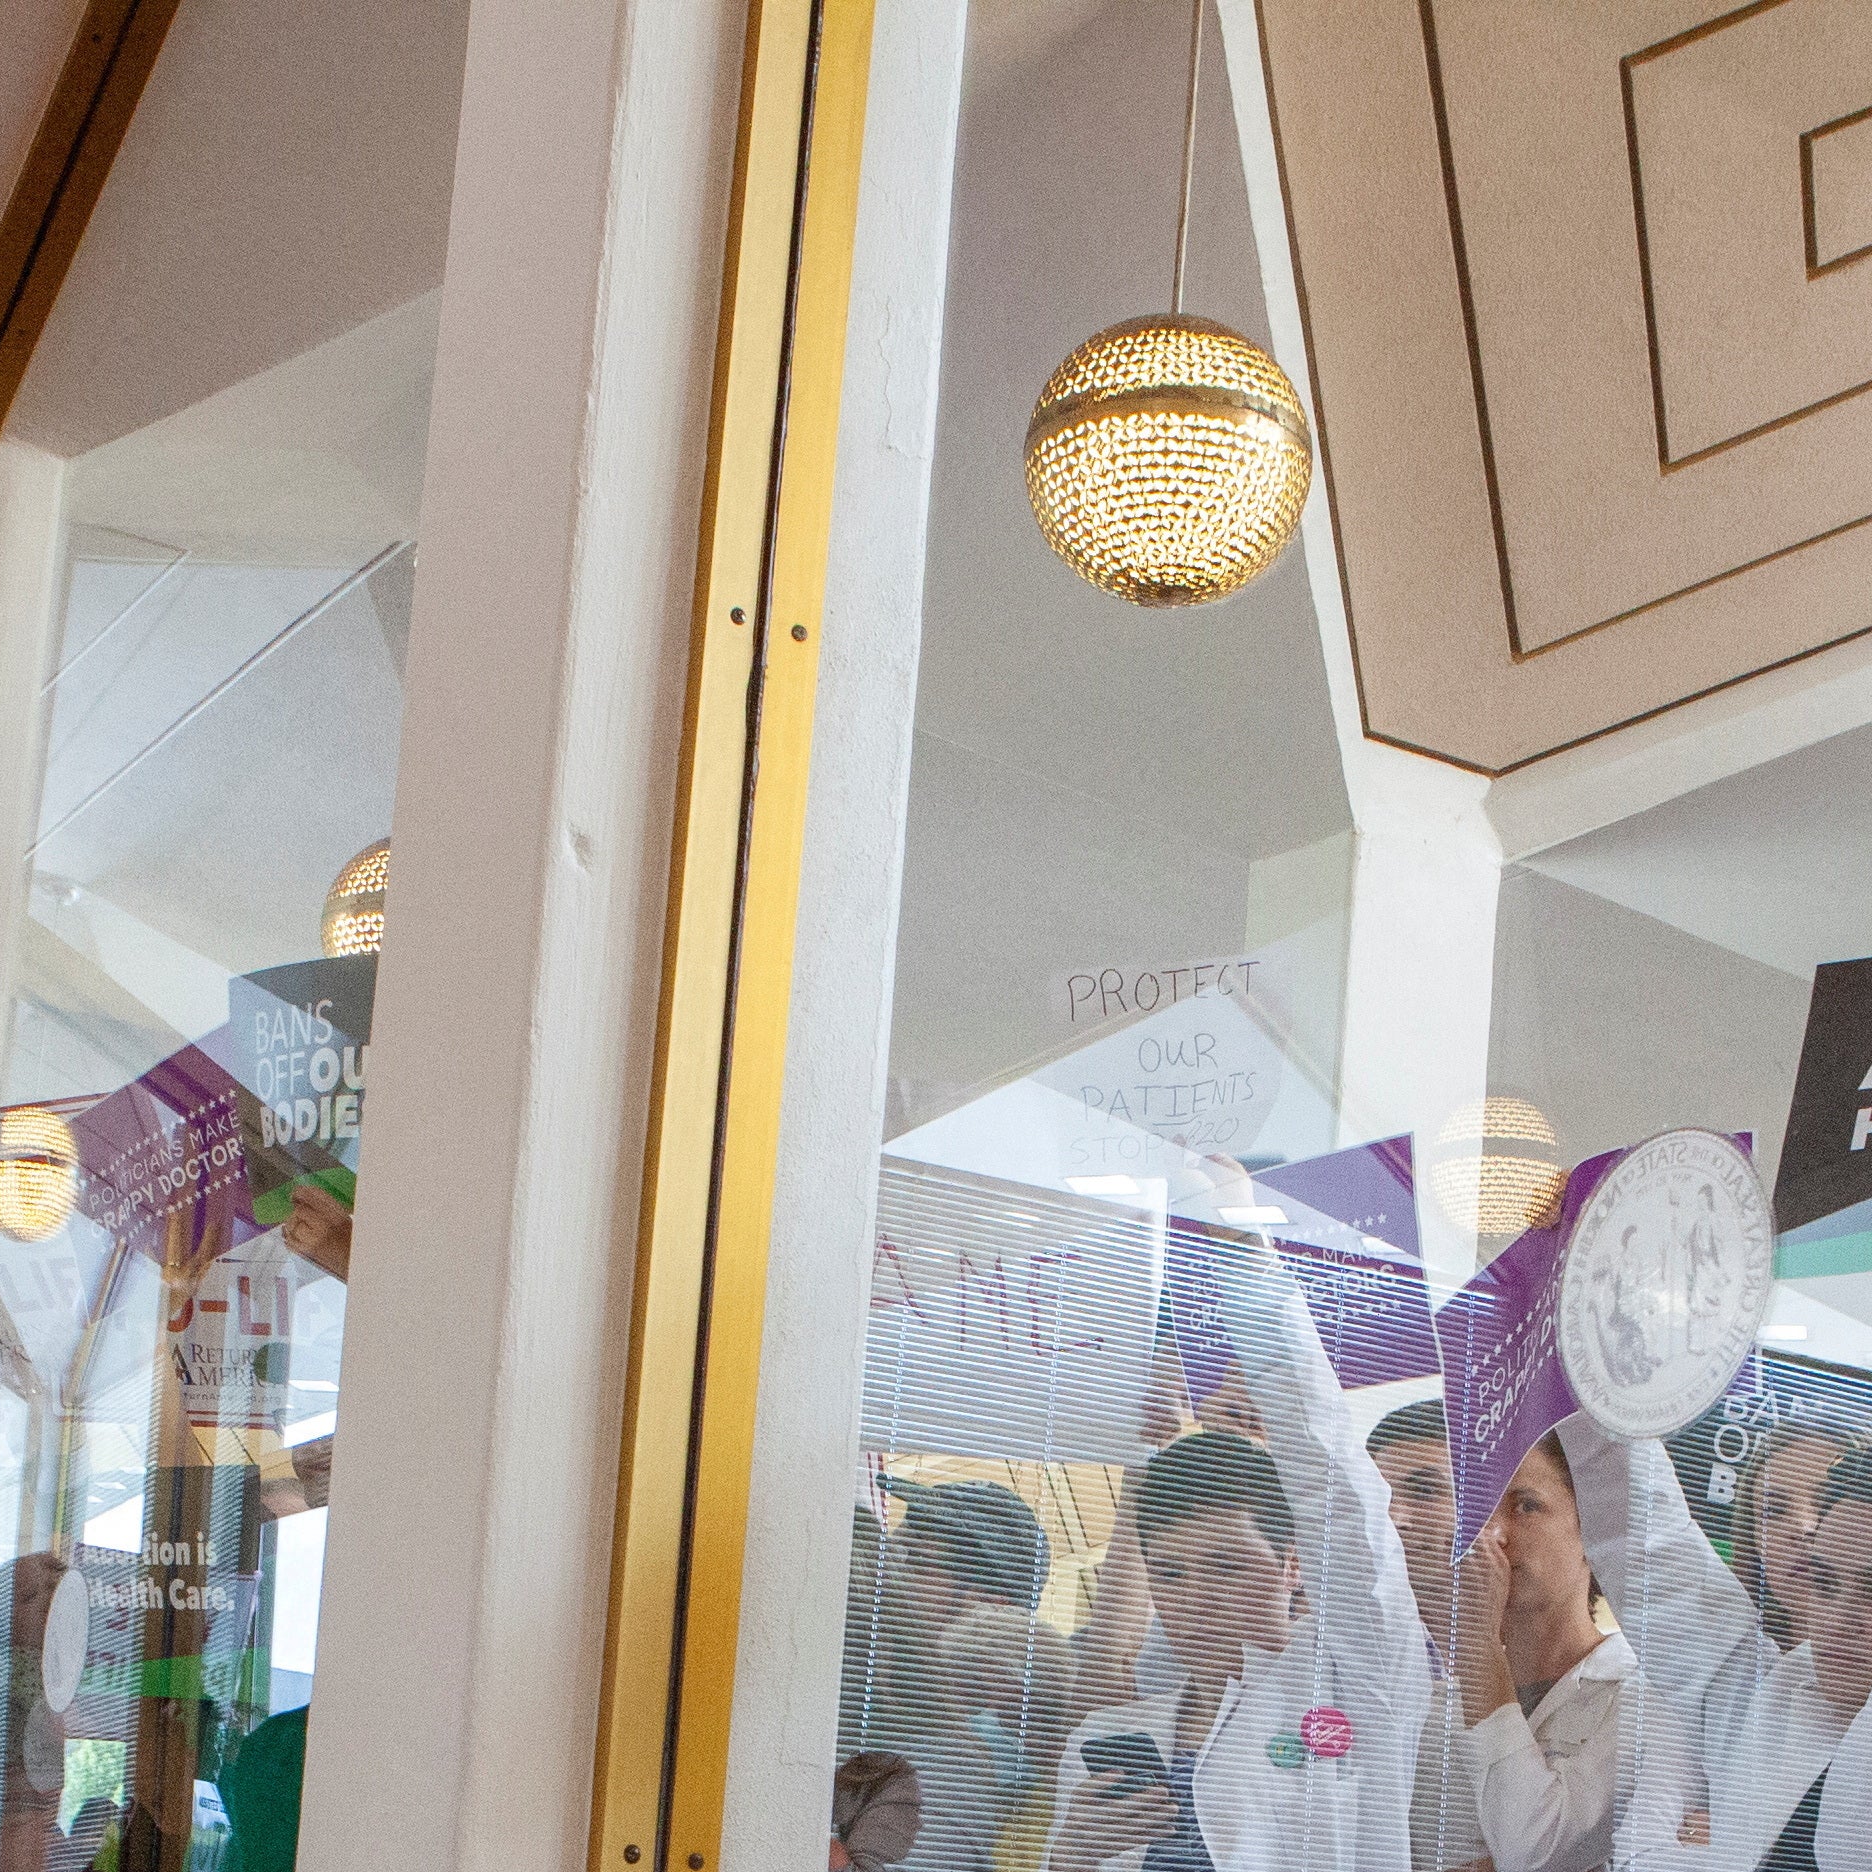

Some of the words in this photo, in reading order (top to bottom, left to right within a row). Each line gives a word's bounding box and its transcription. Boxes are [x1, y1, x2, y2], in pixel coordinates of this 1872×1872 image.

[1068, 961, 1260, 1021] PROTECT
[255, 1000, 333, 1055] BANS
[256, 1052, 304, 1100] OFF
[1139, 1033, 1218, 1072] OUR
[1081, 1072, 1257, 1121] PATIENTS
[89, 1140, 184, 1211] POLITICIANS
[189, 1109, 240, 1148] MAKE
[168, 1578, 235, 1612] Care.
